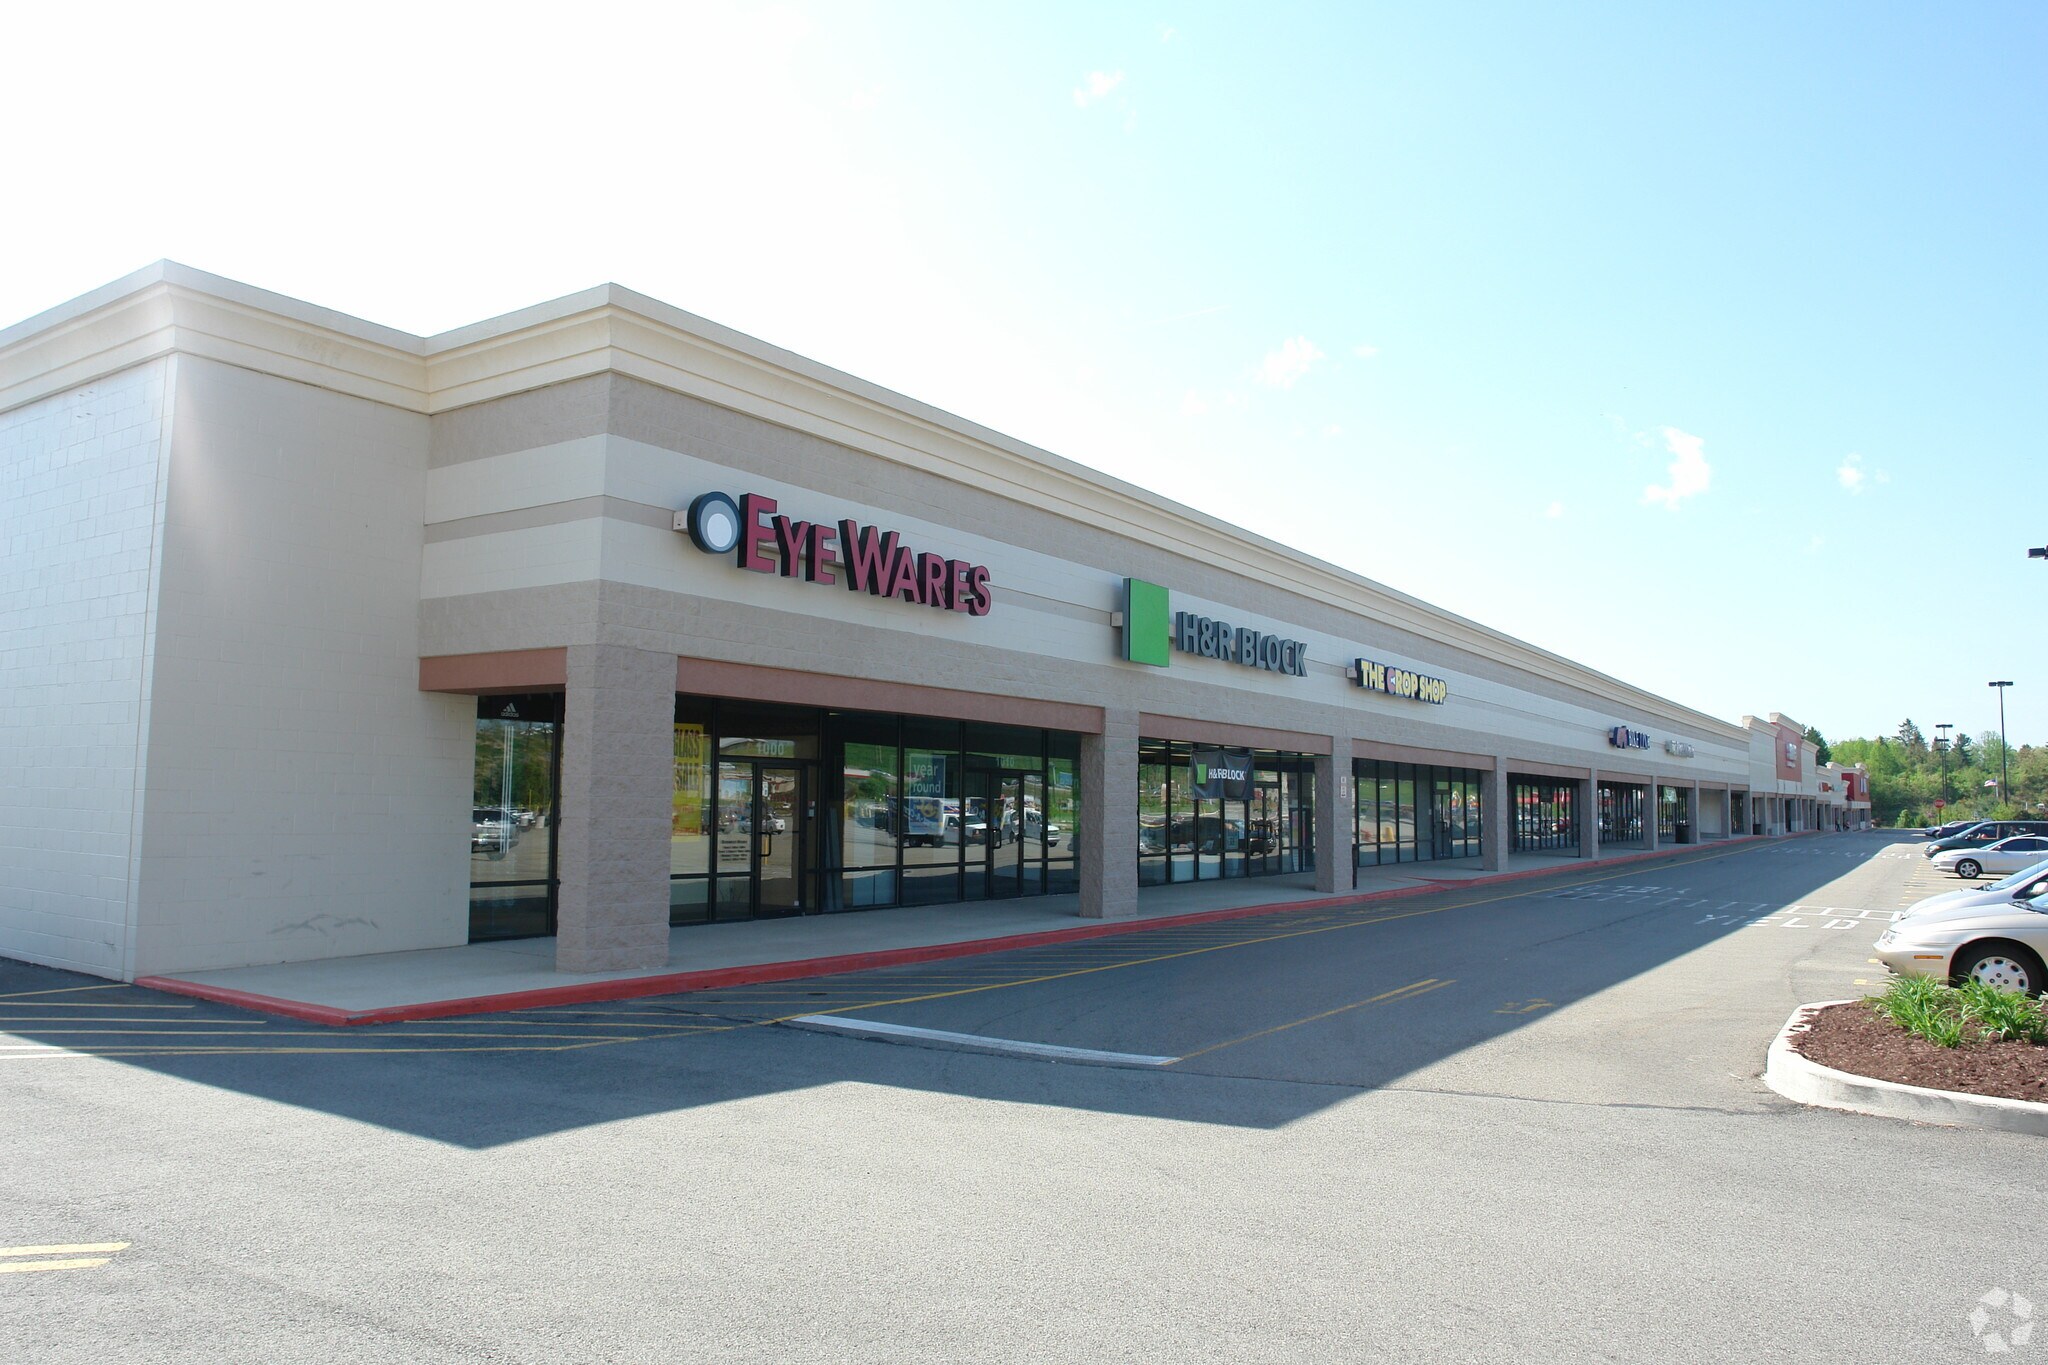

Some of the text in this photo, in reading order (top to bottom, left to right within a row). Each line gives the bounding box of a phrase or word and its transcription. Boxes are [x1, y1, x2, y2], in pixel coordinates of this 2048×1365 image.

[738, 492, 991, 616] EYE WARES
[1176, 611, 1307, 677] H&R BLOCK
[1355, 658, 1385, 692] THE
[1417, 674, 1447, 705] SHOP
[756, 742, 785, 756] 1000
[913, 763, 938, 778] year
[1222, 768, 1245, 780] BLOCK
[912, 781, 941, 793] round
